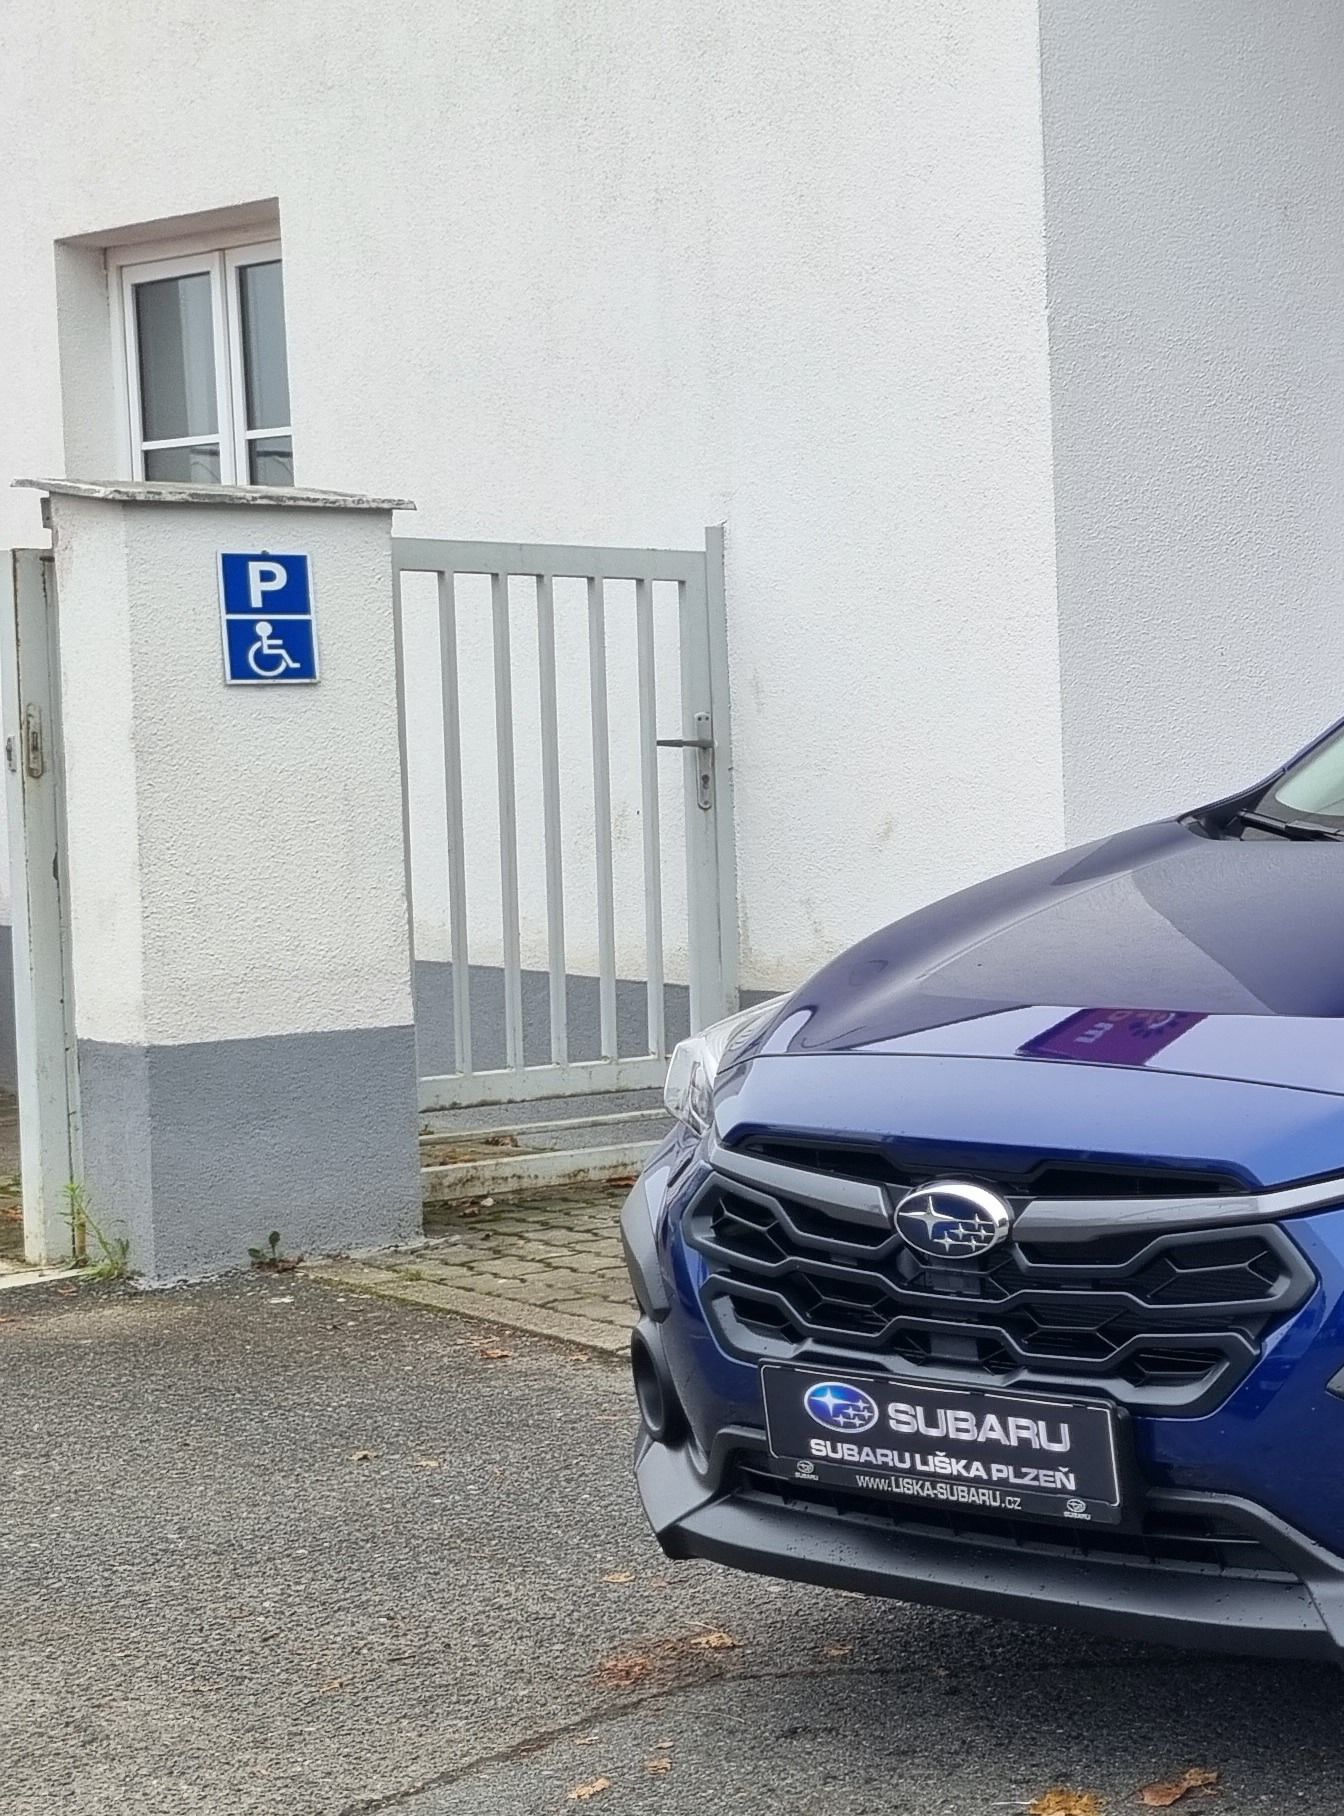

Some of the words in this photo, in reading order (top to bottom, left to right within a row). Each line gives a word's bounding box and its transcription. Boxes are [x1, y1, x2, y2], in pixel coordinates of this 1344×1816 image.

[248, 561, 287, 608] P
[887, 1403, 1070, 1452] SUBARU
[810, 1439, 912, 1469] SUBARU
[916, 1451, 988, 1481] LIŠKA
[992, 1466, 1076, 1490] PLZEŇ
[856, 1474, 1022, 1511] www.LISKA-SUBARU.cz
